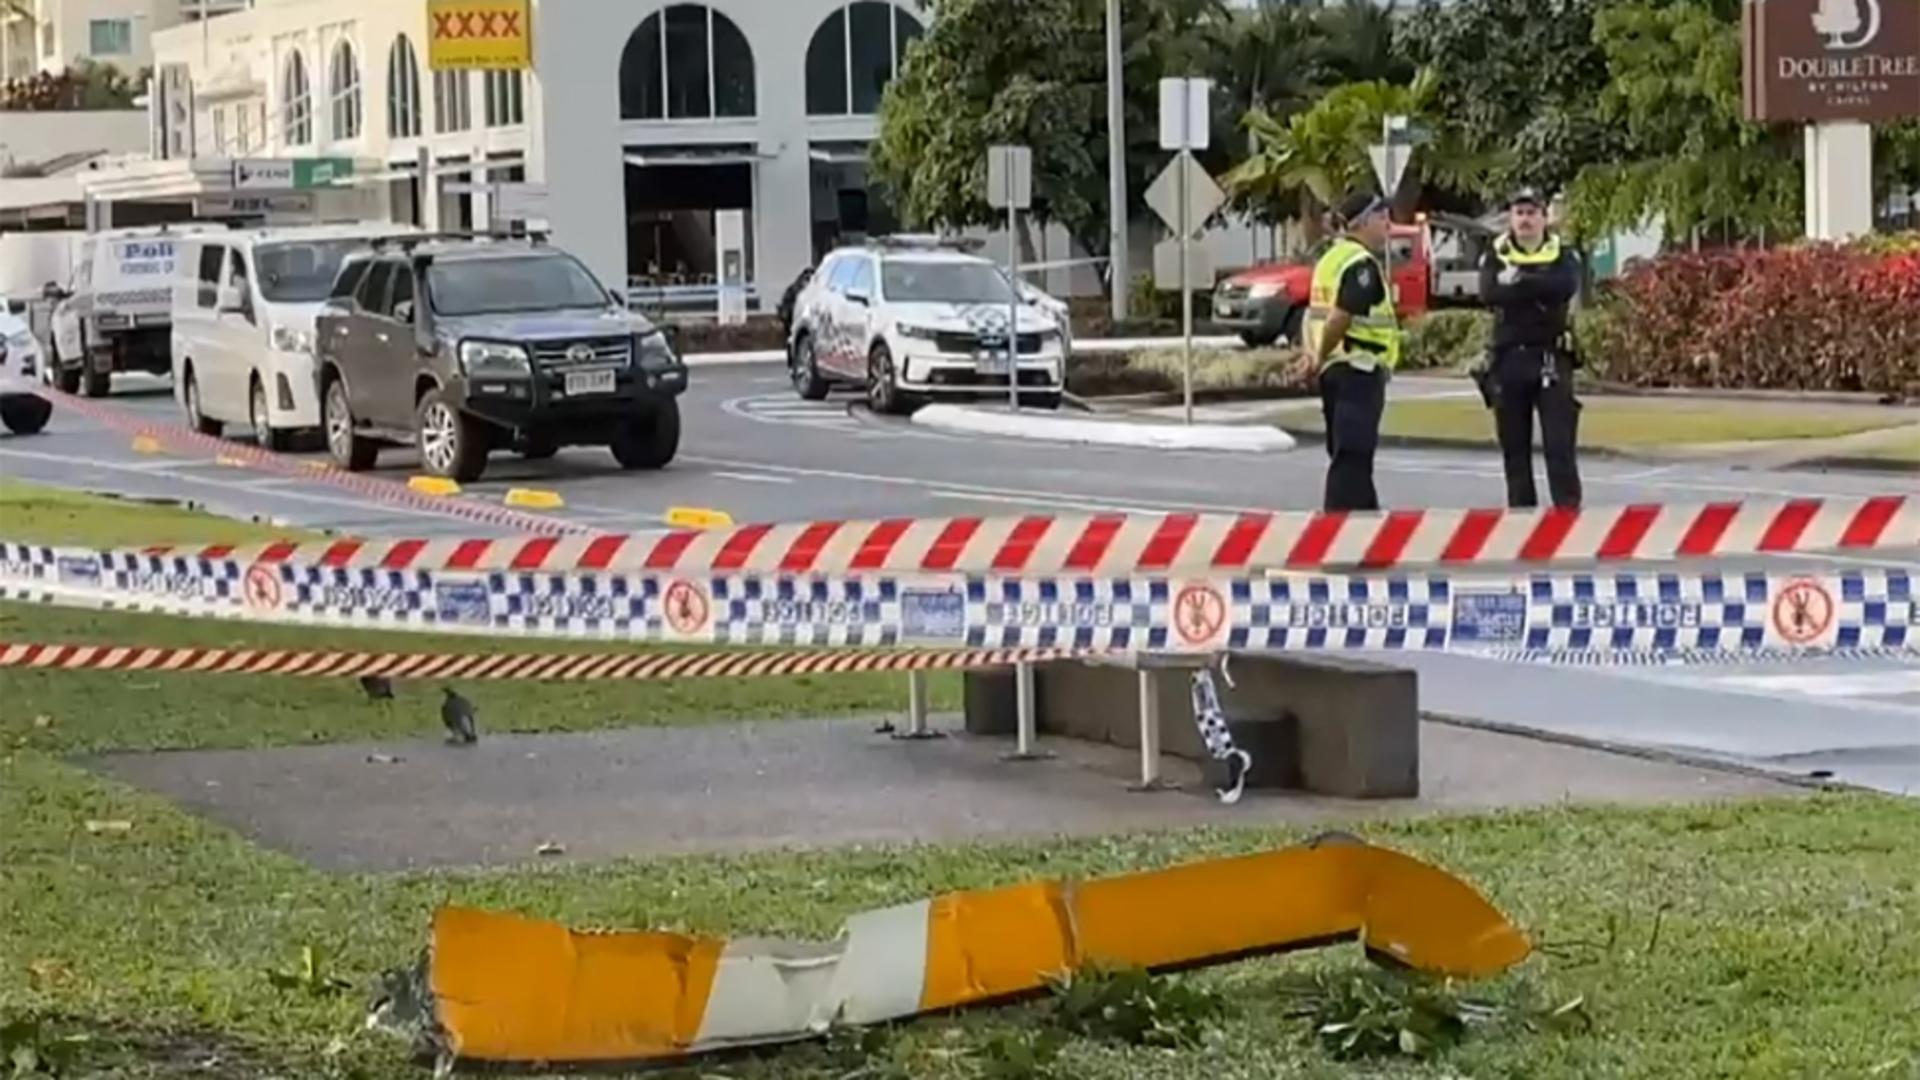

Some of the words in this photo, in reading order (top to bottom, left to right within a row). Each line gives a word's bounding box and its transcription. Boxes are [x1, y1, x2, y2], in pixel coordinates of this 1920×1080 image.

[433, 11, 520, 39] XXXX
[1808, 81, 1826, 93] BY
[1835, 80, 1889, 93] HILTON
[126, 241, 173, 259] Poli
[1004, 603, 1113, 628] POLICE
[1289, 604, 1405, 628] POLICE
[1575, 603, 1701, 628] POLICE
